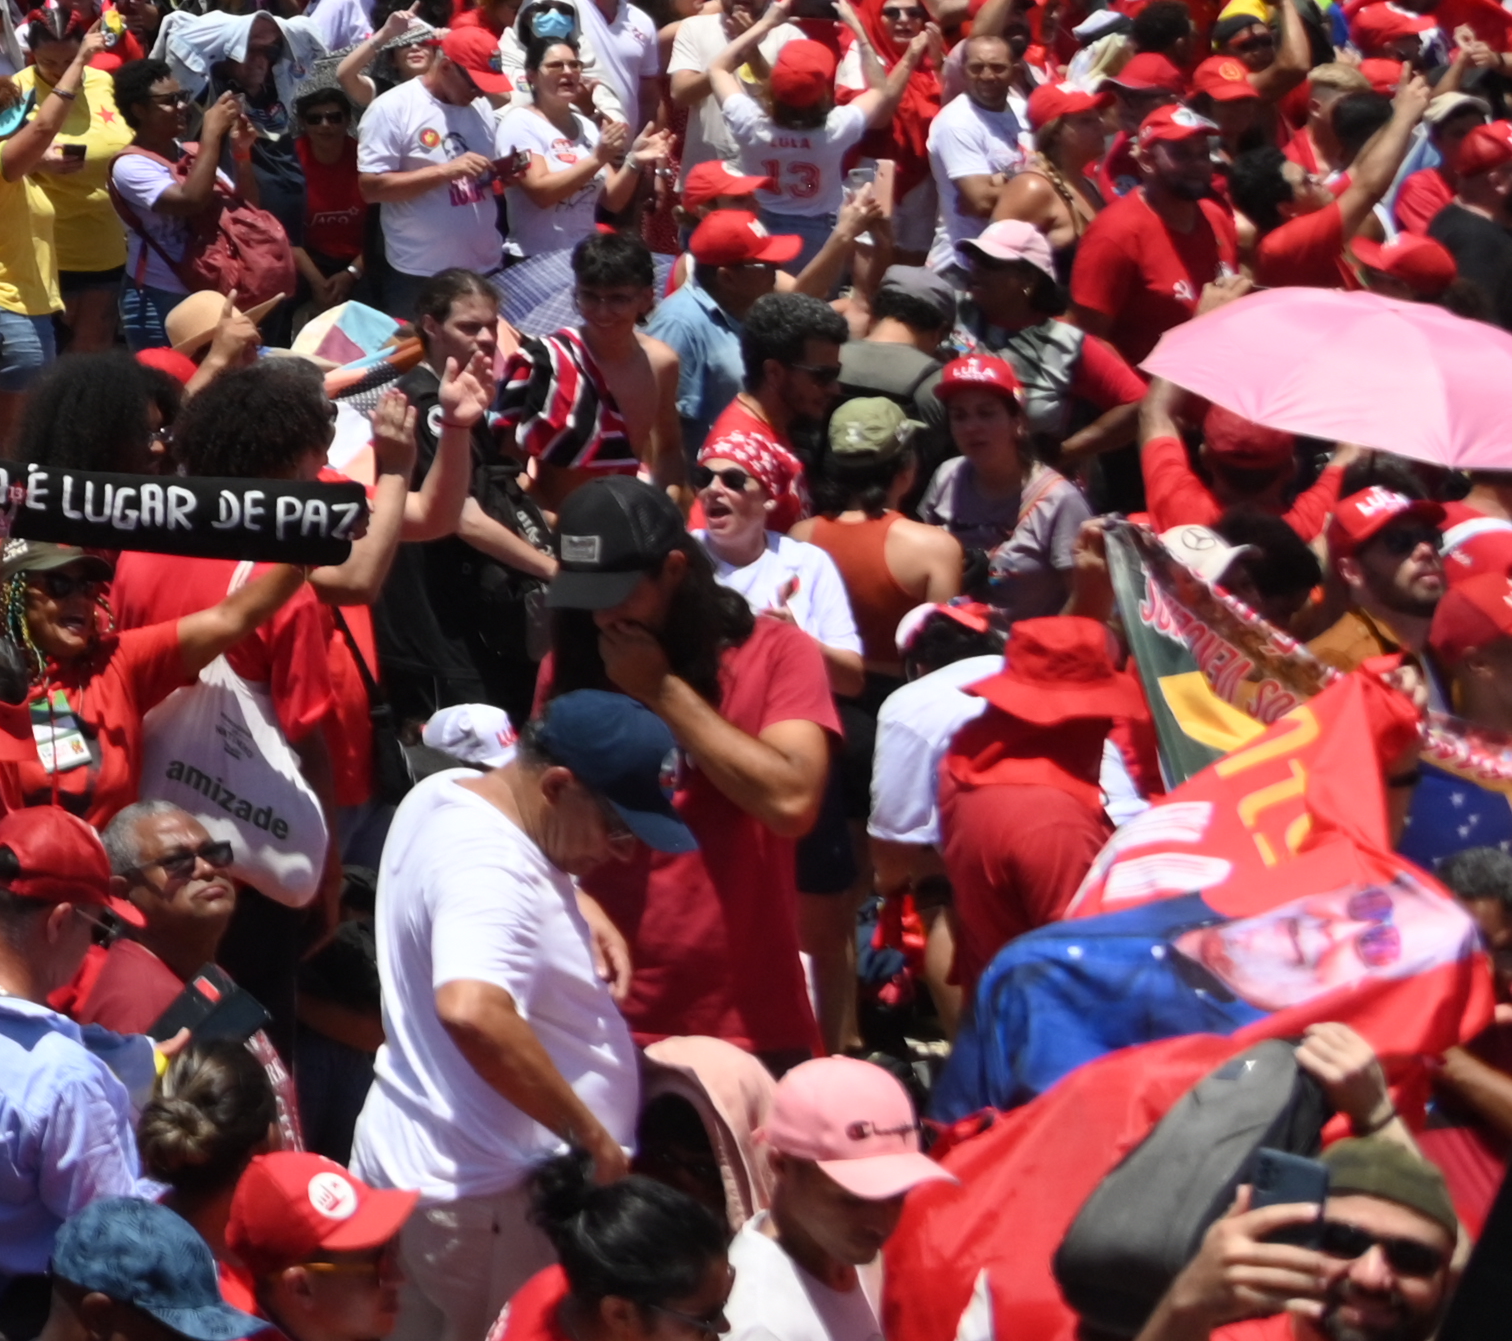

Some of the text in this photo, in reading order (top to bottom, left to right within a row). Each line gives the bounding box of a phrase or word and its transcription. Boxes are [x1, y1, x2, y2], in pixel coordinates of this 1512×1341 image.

[760, 158, 821, 199] 13
[952, 365, 997, 380] LULA
[7, 485, 26, 503] 13
[25, 461, 49, 511] É
[62, 480, 198, 530] LUGAR
[219, 491, 267, 531] DE
[275, 495, 361, 542] PAZ
[164, 756, 292, 842] amizade
